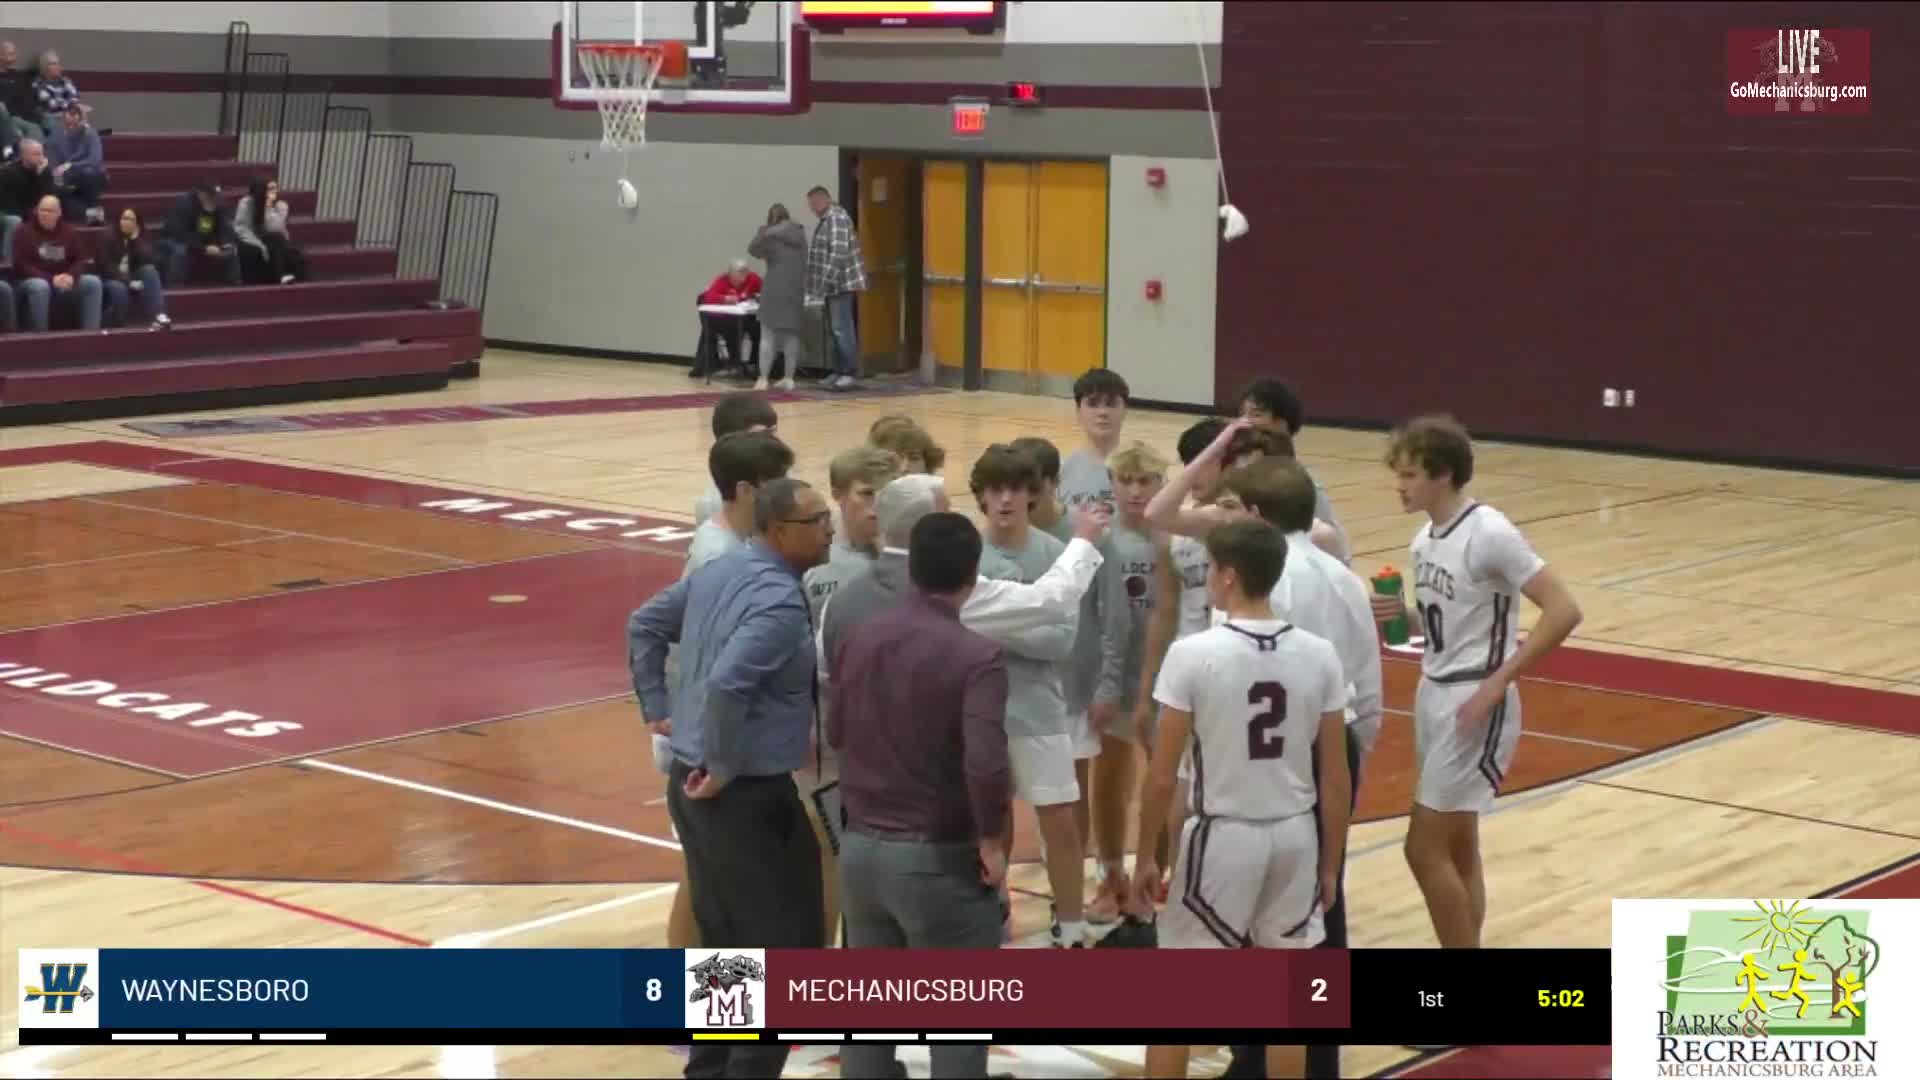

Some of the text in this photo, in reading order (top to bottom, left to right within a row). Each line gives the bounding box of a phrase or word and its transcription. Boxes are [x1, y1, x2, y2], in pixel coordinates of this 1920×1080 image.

[419, 498, 697, 541] MECH
[0, 662, 304, 737] ILDCATS
[1247, 681, 1287, 760] 2
